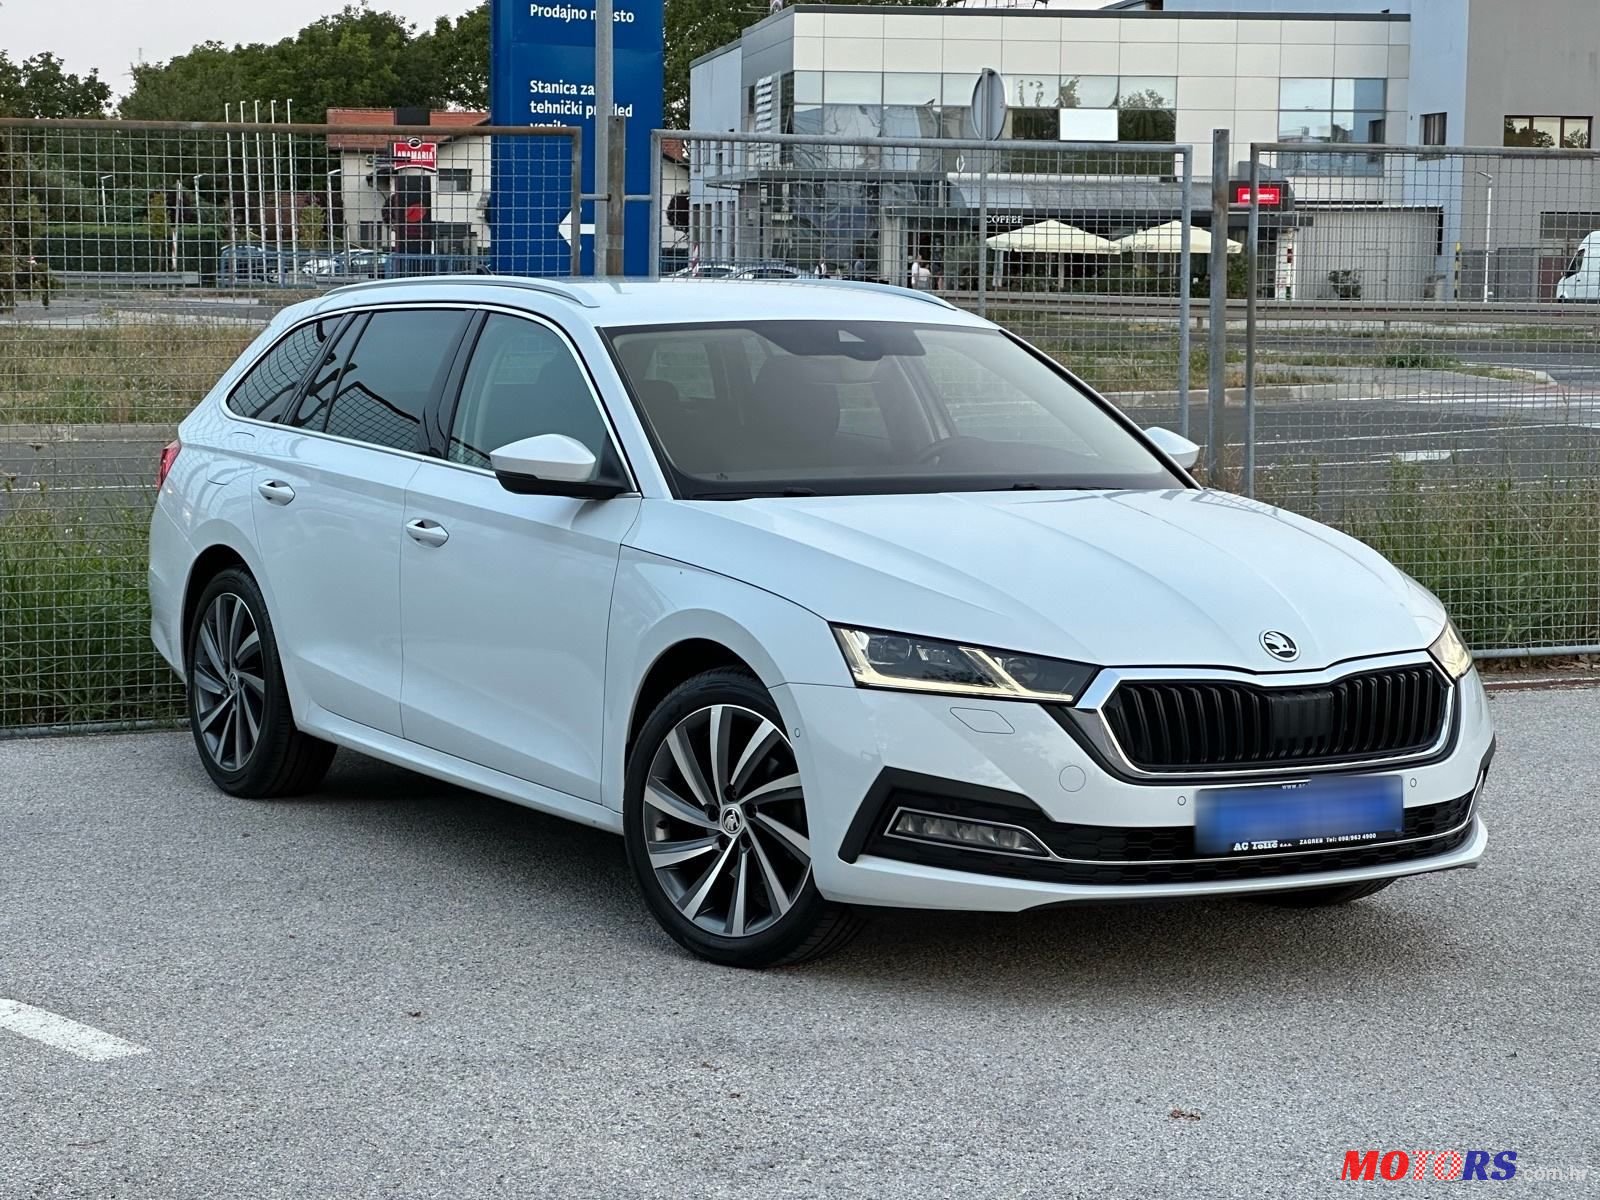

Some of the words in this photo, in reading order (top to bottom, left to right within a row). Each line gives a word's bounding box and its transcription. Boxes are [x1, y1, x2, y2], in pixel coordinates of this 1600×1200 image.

[530, 4, 587, 23] Prodajno
[530, 79, 578, 95] Stanica
[580, 84, 596, 96] za
[530, 99, 583, 115] tehnički
[1233, 842, 1249, 851] AC
